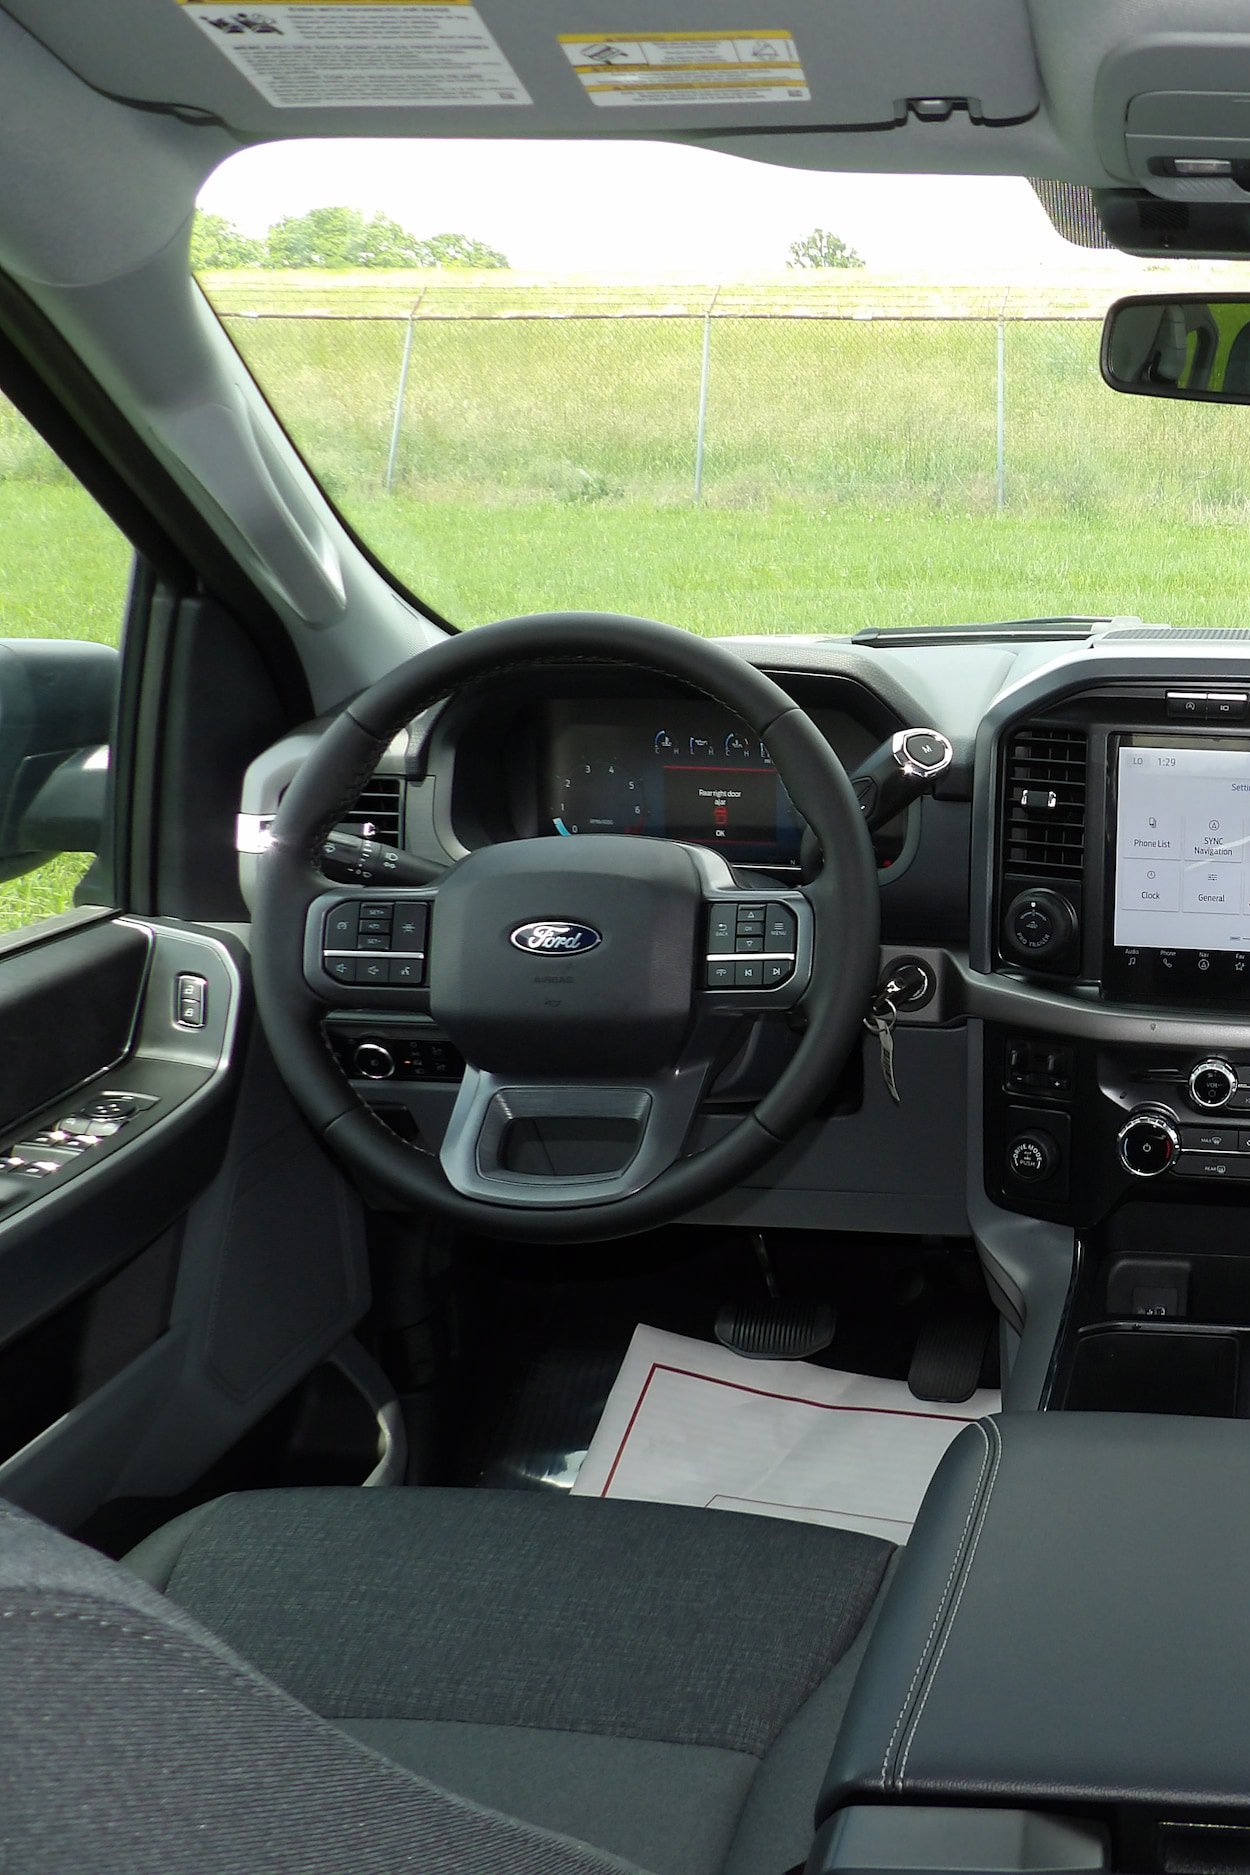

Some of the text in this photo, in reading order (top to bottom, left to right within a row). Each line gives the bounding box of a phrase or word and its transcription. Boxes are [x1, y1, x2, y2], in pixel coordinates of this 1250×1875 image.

[922, 745, 932, 753] M
[1158, 758, 1176, 766] 1:29
[586, 765, 590, 774] 3
[565, 779, 570, 787] 2
[629, 781, 634, 789] 5
[699, 789, 713, 797] Rear
[713, 790, 726, 798] right
[561, 803, 564, 811] 1
[635, 806, 640, 814] 6
[572, 825, 578, 833] 0
[1134, 839, 1170, 848] Phone List
[1204, 837, 1224, 845] SYNC
[1194, 847, 1232, 856] Navigation
[1198, 894, 1224, 902] General
[528, 926, 582, 948] Ford
[1017, 933, 1050, 947] PRO TRAILER
